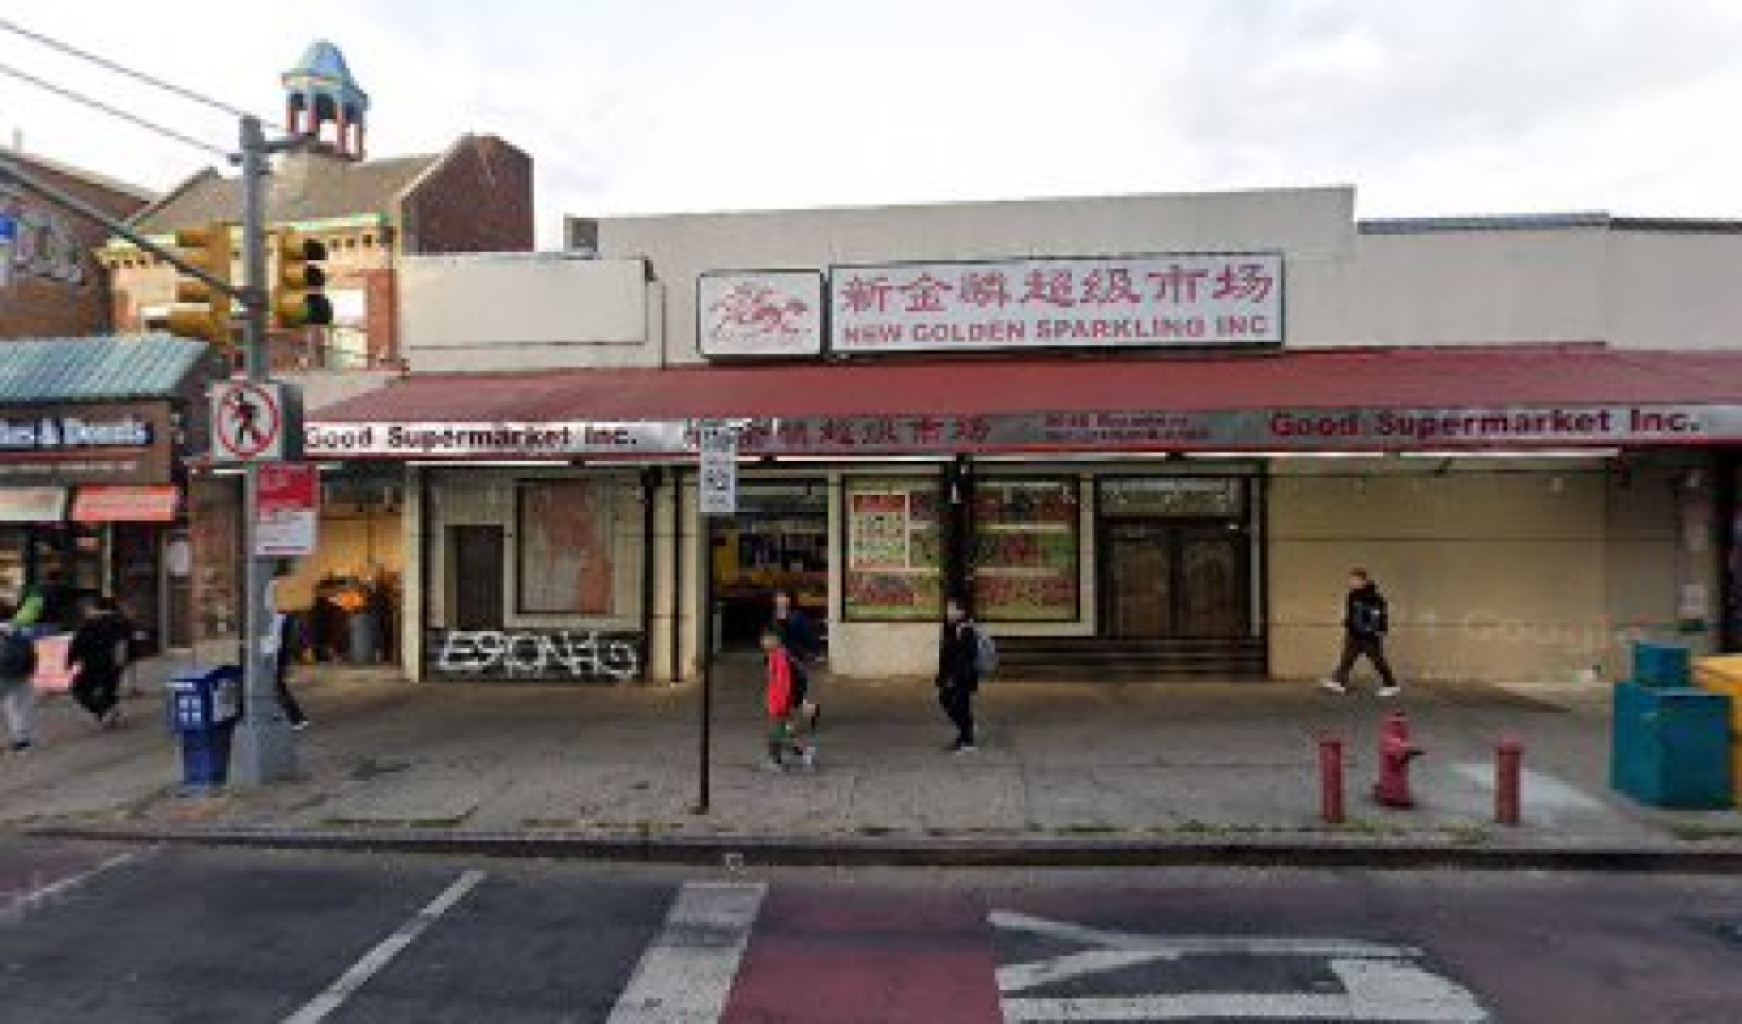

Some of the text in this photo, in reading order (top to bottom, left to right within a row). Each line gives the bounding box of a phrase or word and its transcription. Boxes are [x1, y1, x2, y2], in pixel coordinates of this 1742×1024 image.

[844, 314, 1269, 345] NEW GOLDEN SPARKLING INC
[303, 426, 638, 452] Good Supermarket Inc.
[1269, 408, 1701, 440] Good Supermarket Inc.
